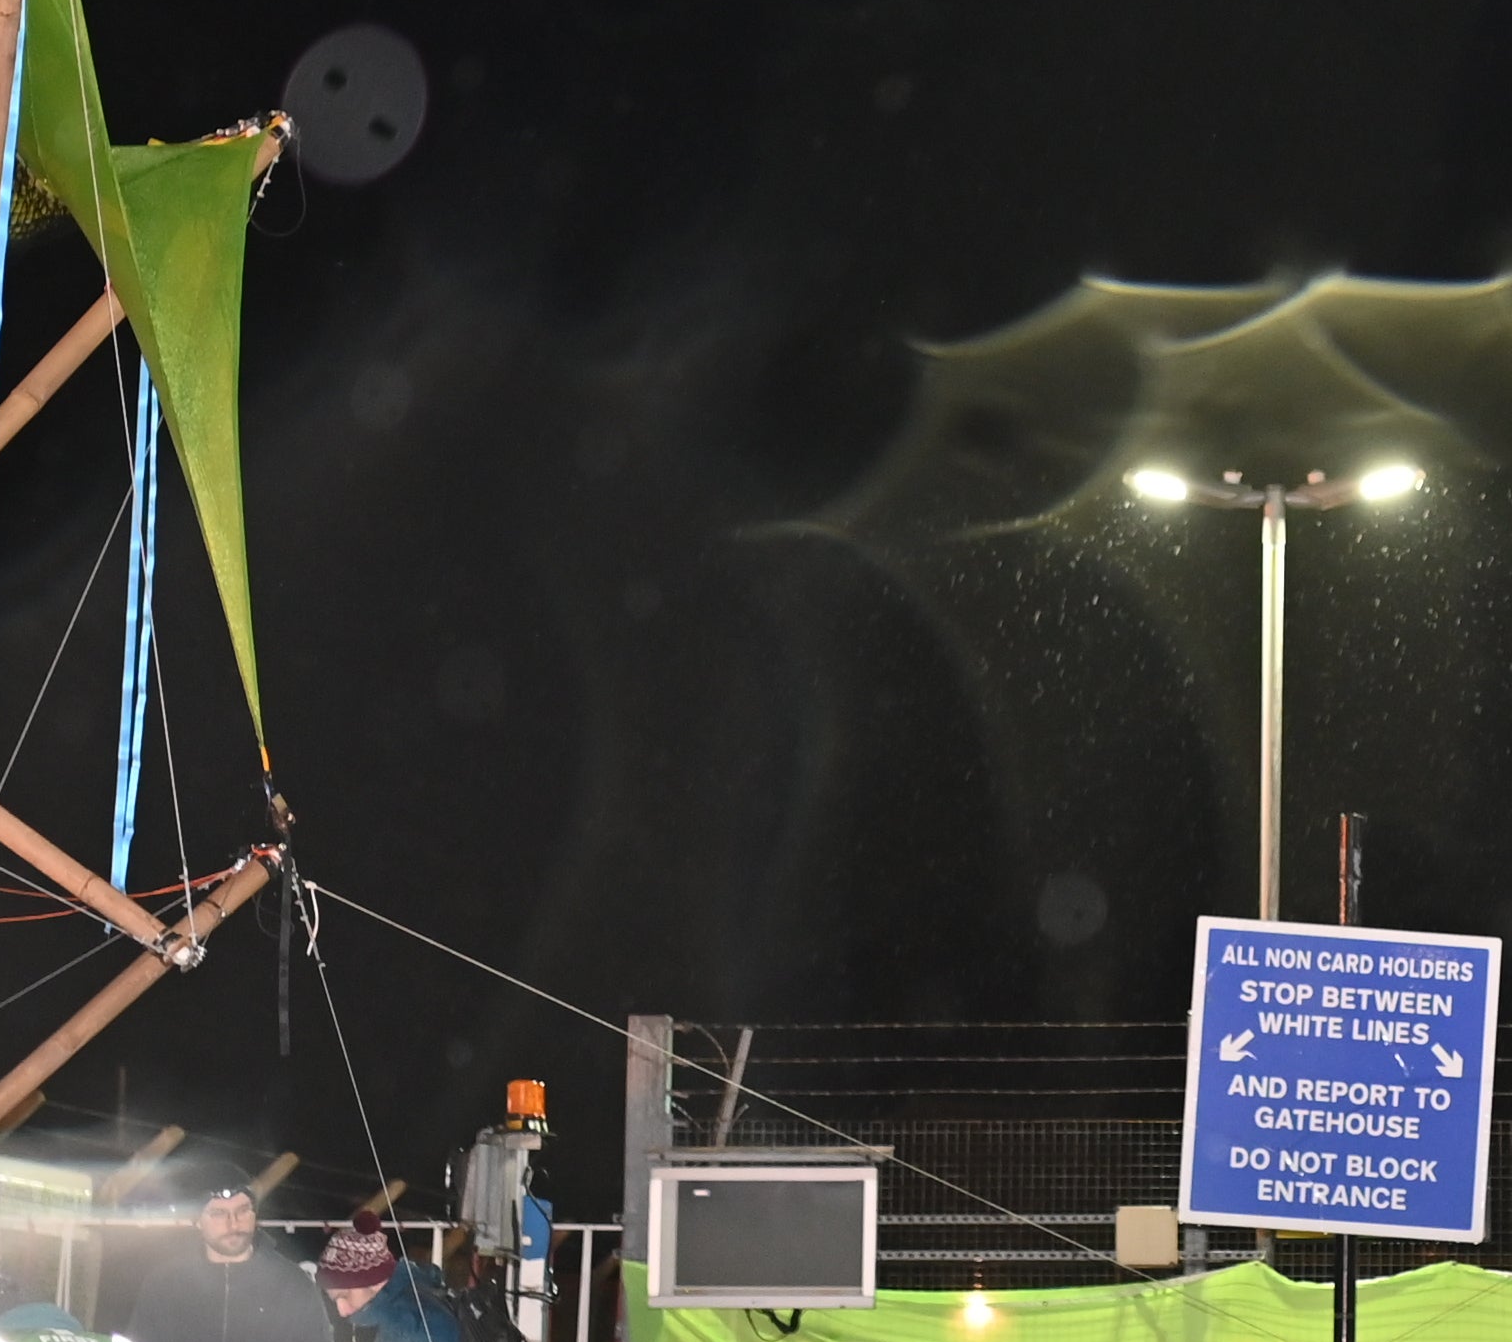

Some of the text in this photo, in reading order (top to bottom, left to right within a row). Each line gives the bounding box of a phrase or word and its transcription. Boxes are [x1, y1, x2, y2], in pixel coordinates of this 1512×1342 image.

[1222, 945, 1474, 983] ALL NON CARD HOLDERS
[1239, 979, 1453, 1017] STOP BETWEEN
[1258, 1011, 1430, 1045] WHITE LINES
[1227, 1074, 1452, 1111] AND REPORT TO
[1254, 1105, 1421, 1140] GATEHOUSE
[1229, 1146, 1438, 1183] DO NOT BLOCK
[1257, 1178, 1408, 1211] ENTRANCE
